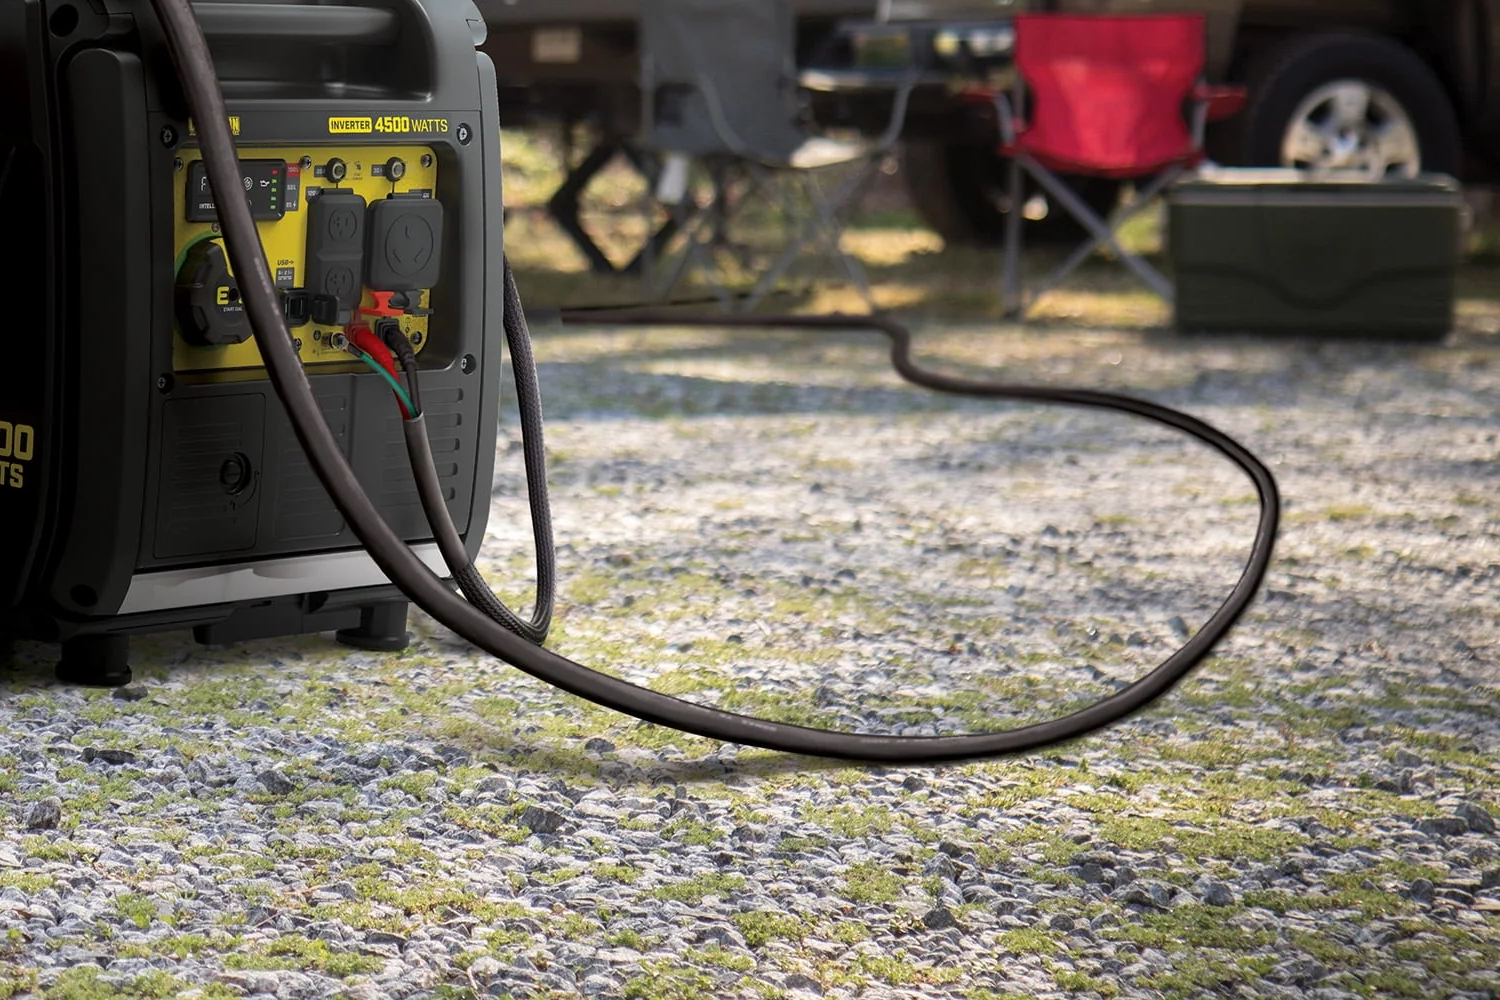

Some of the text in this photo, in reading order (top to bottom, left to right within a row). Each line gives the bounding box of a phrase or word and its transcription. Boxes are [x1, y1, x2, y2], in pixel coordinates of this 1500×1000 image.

[331, 116, 449, 133] INVERTER 4500 WATTS
